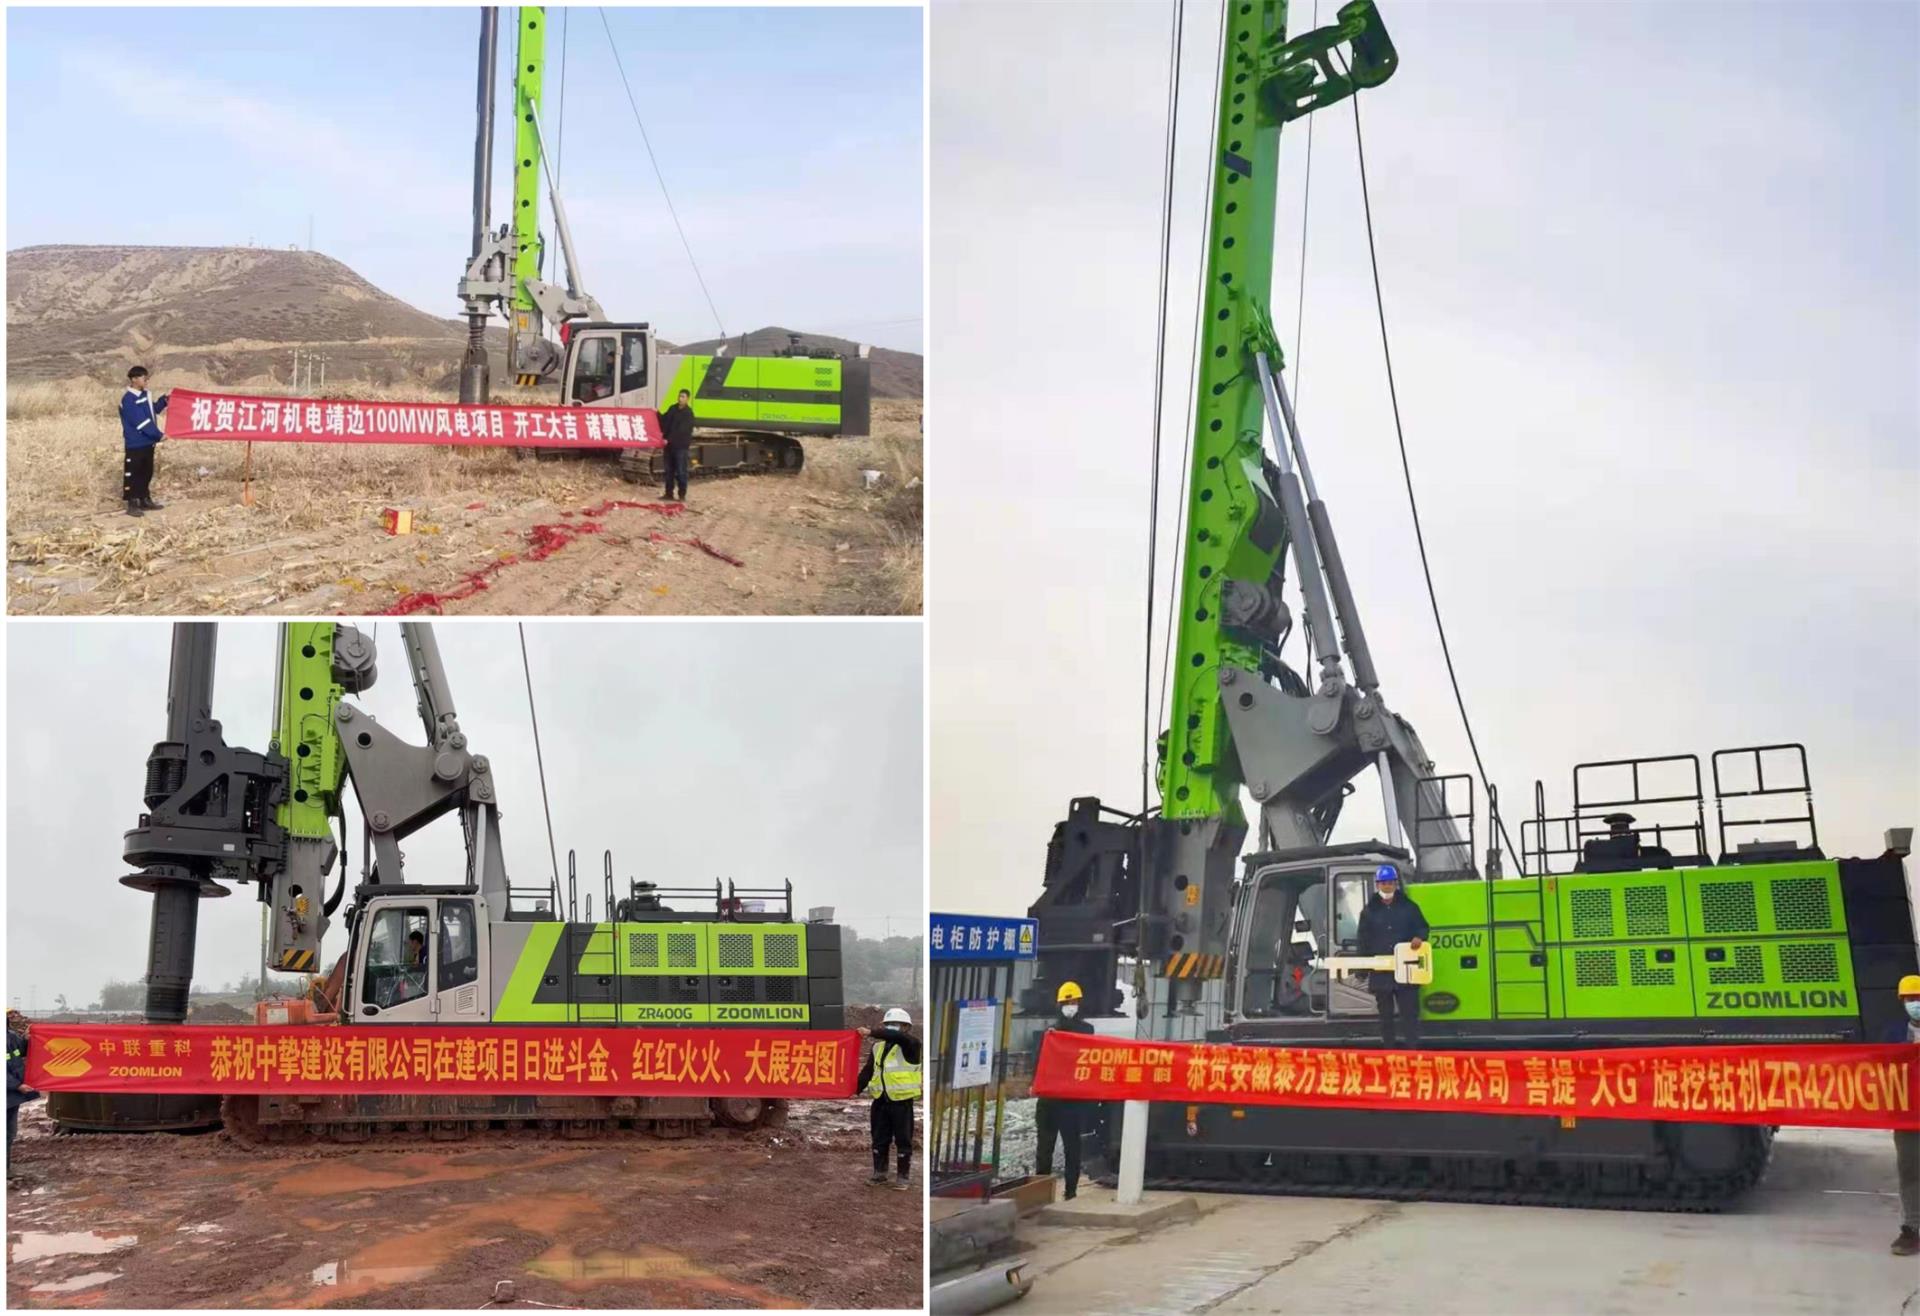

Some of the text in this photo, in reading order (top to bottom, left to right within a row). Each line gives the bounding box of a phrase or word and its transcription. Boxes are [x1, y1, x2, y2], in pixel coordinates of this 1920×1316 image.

[513, 408, 579, 441] 开工大吉
[931, 925, 1017, 950] 电柜防护棚
[1431, 932, 1482, 950] 20GW
[1706, 990, 1848, 1010] ZOOMLION
[637, 1006, 693, 1020] ZR400G
[716, 1006, 804, 1020] ZOOMLION
[99, 1038, 192, 1058] 中联重科
[1076, 1047, 1174, 1066] ZOOMLION
[108, 1065, 182, 1078] ZOOMLION
